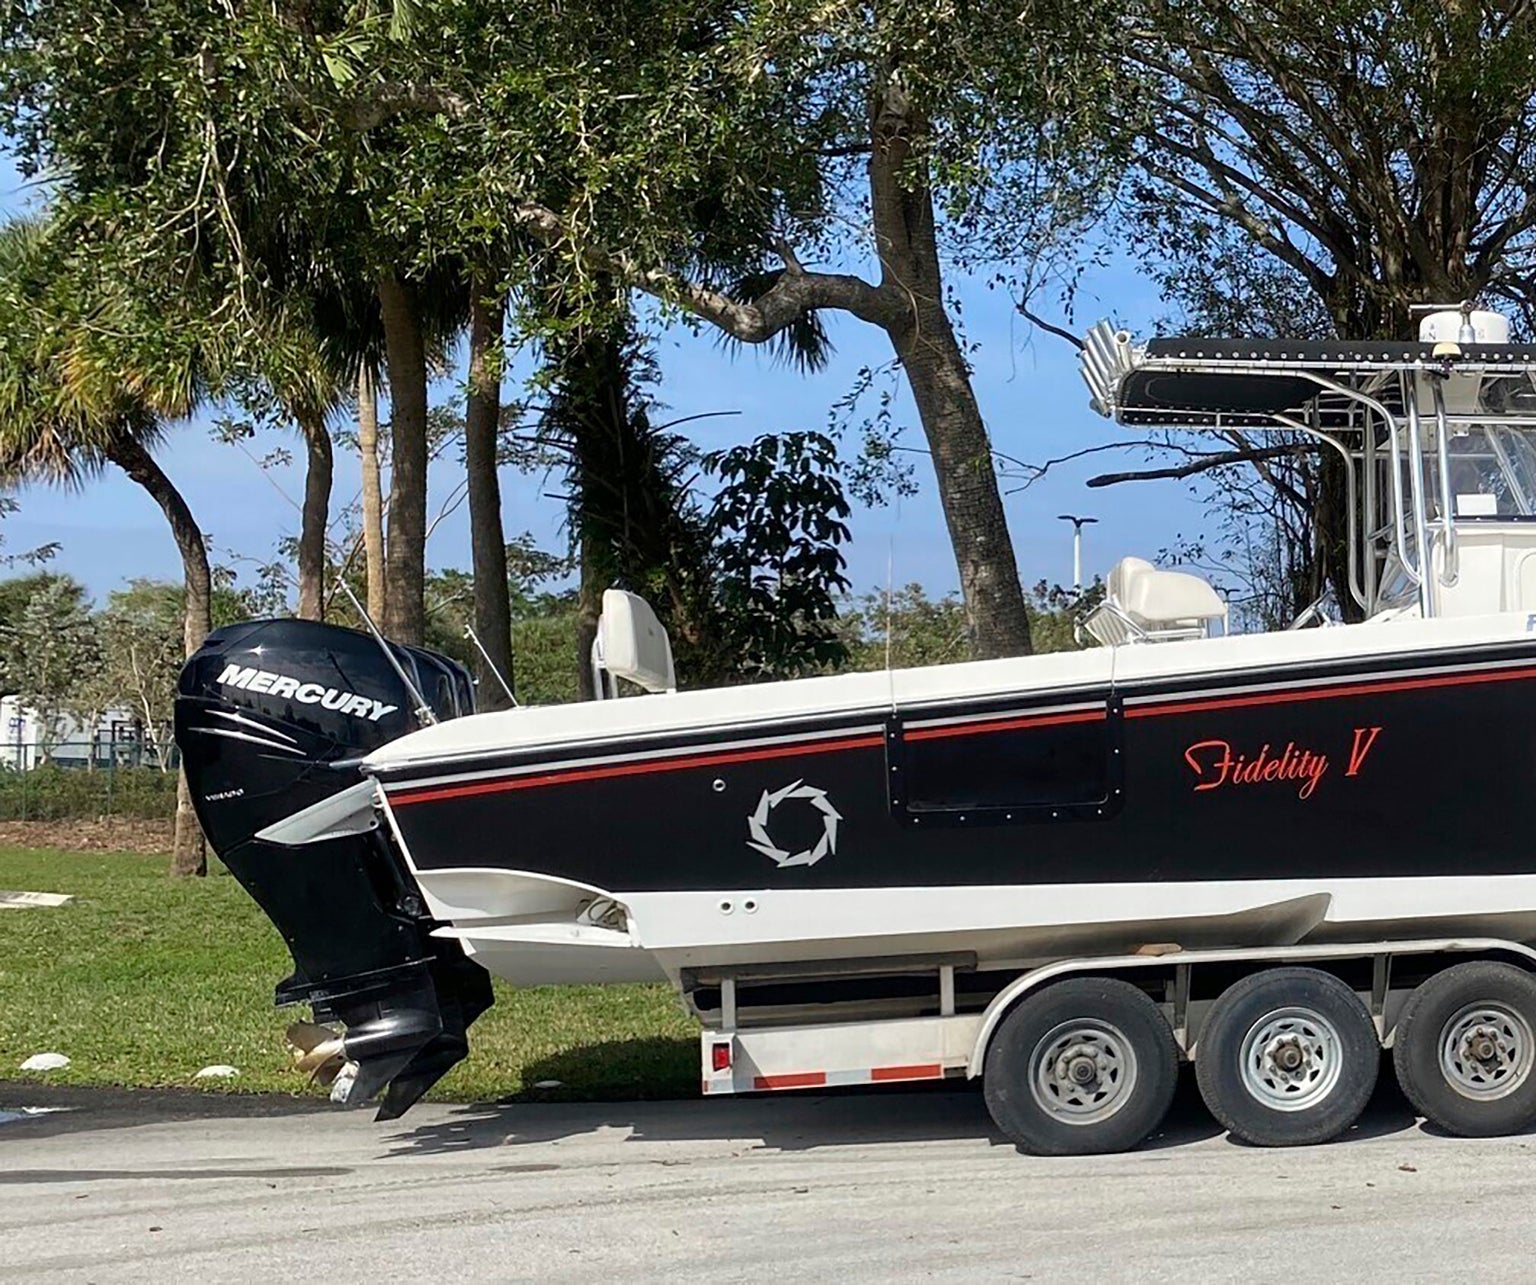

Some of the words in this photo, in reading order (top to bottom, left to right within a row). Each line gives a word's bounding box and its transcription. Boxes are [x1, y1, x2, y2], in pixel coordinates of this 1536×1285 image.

[216, 663, 398, 721] MERCURY
[1185, 740, 1329, 800] Fidelity
[1345, 727, 1383, 777] V
